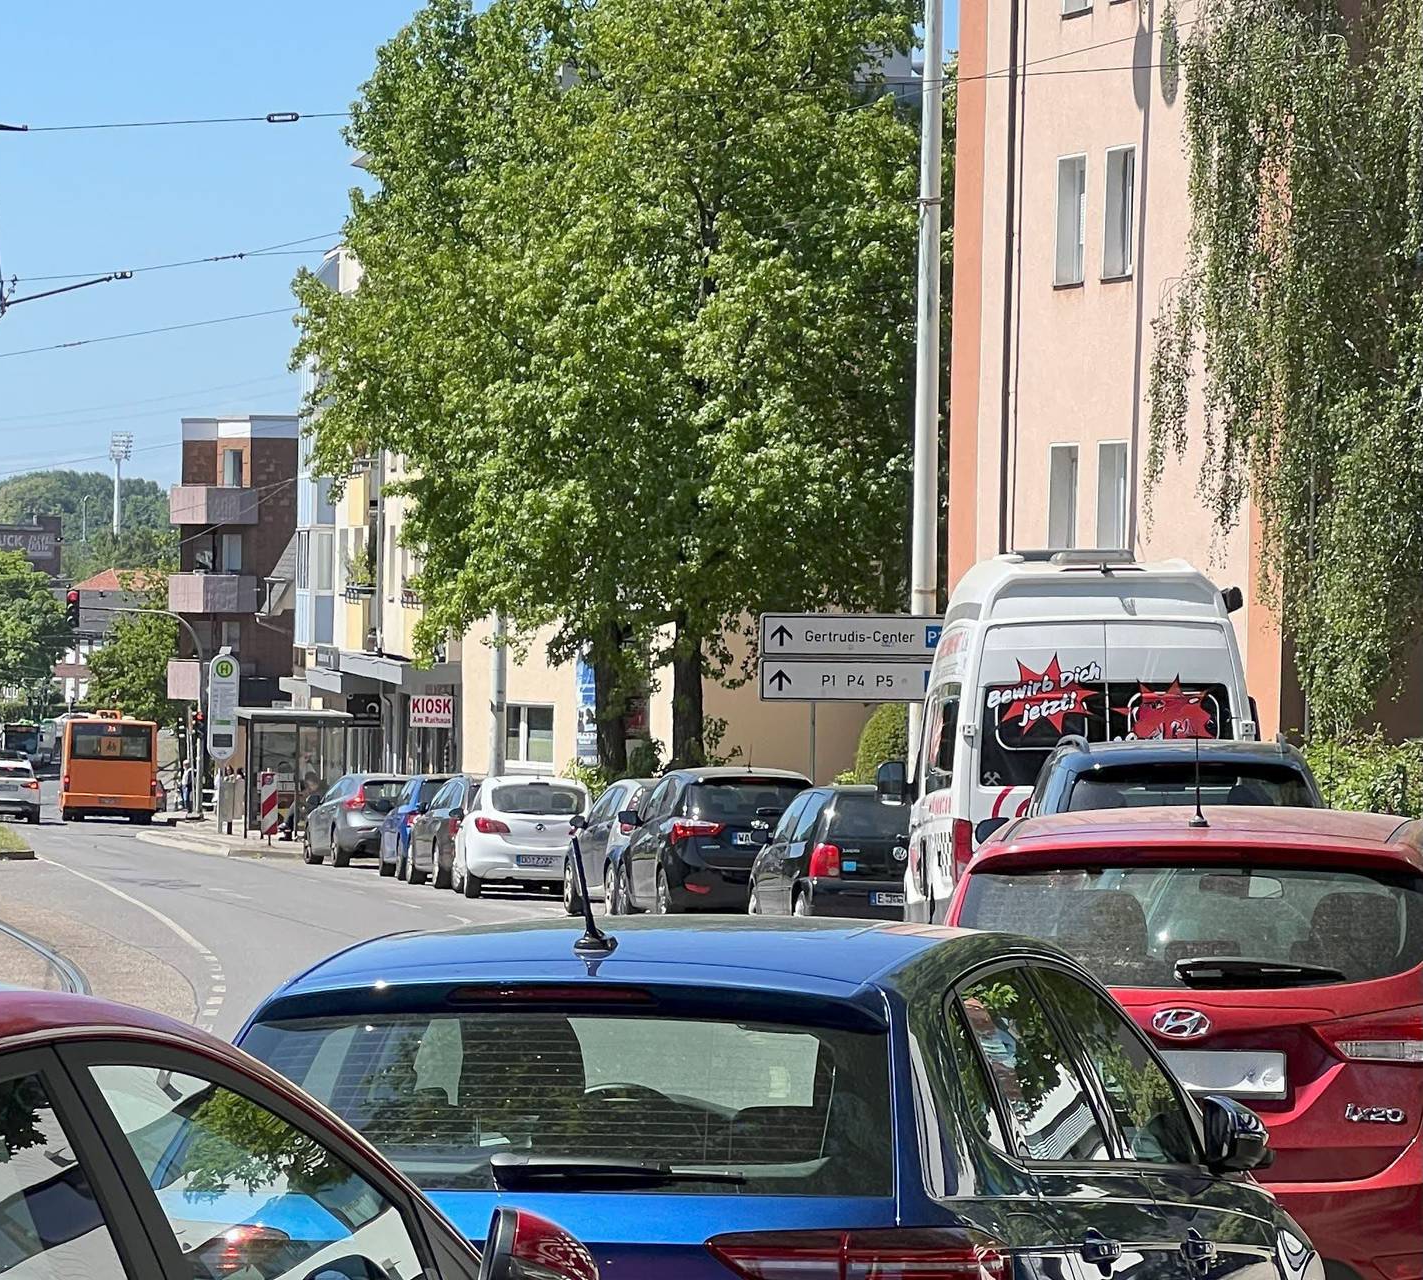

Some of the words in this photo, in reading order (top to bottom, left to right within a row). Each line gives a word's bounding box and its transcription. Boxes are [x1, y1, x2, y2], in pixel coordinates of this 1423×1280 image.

[805, 630, 915, 643] Gertrudis-Center
[927, 631, 942, 643] P
[220, 664, 228, 673] H
[821, 675, 836, 687] P1
[847, 675, 865, 687] P4
[876, 675, 894, 687] P5
[987, 676, 1056, 709] Bewirb
[1060, 661, 1101, 685] Dich
[412, 698, 451, 714] KIOSK
[1018, 692, 1077, 727] jetzt!
